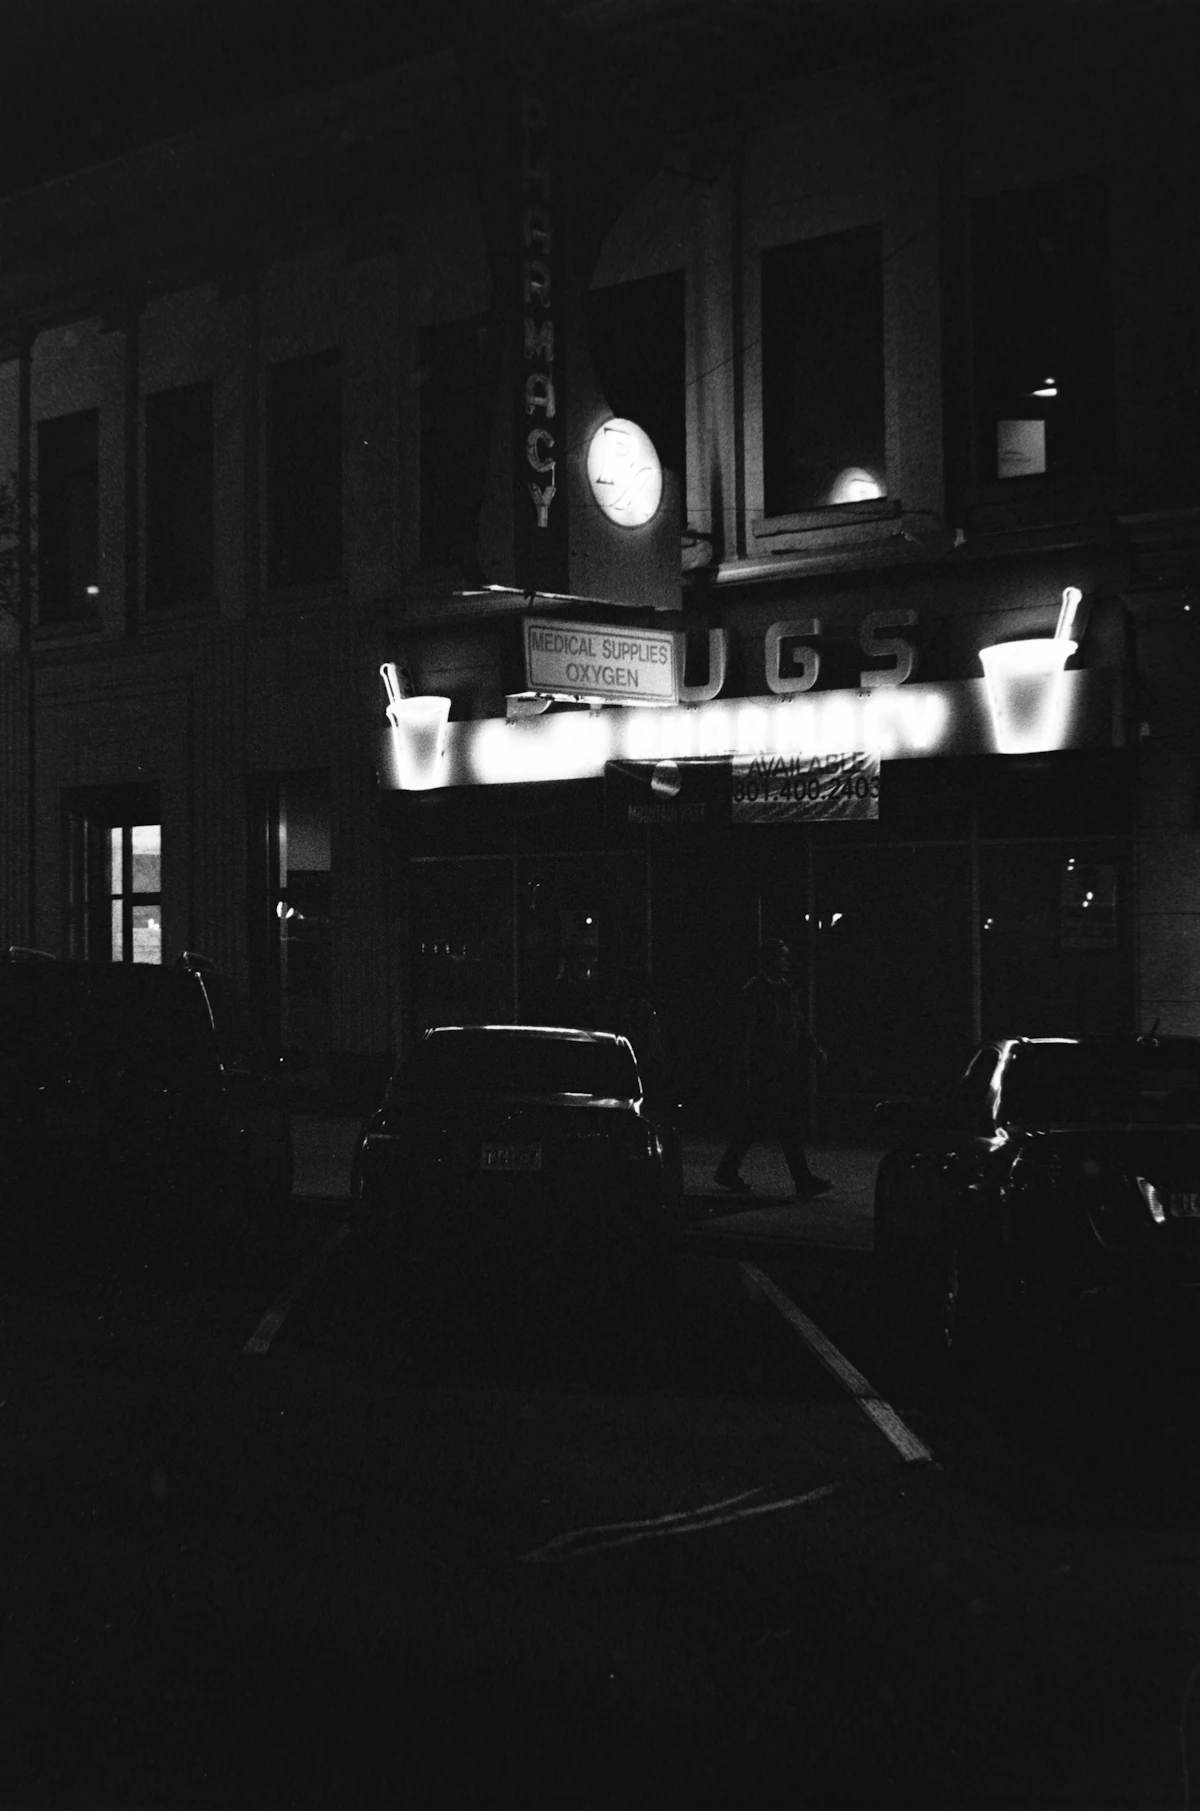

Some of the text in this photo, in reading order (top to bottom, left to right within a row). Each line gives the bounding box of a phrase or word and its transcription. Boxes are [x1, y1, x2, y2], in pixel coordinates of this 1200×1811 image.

[520, 93, 557, 528] PHARMACY
[531, 631, 668, 665] MEDICAL SUPPLIES
[567, 663, 639, 688] OXYGEN
[747, 751, 866, 779] AVAILABLE
